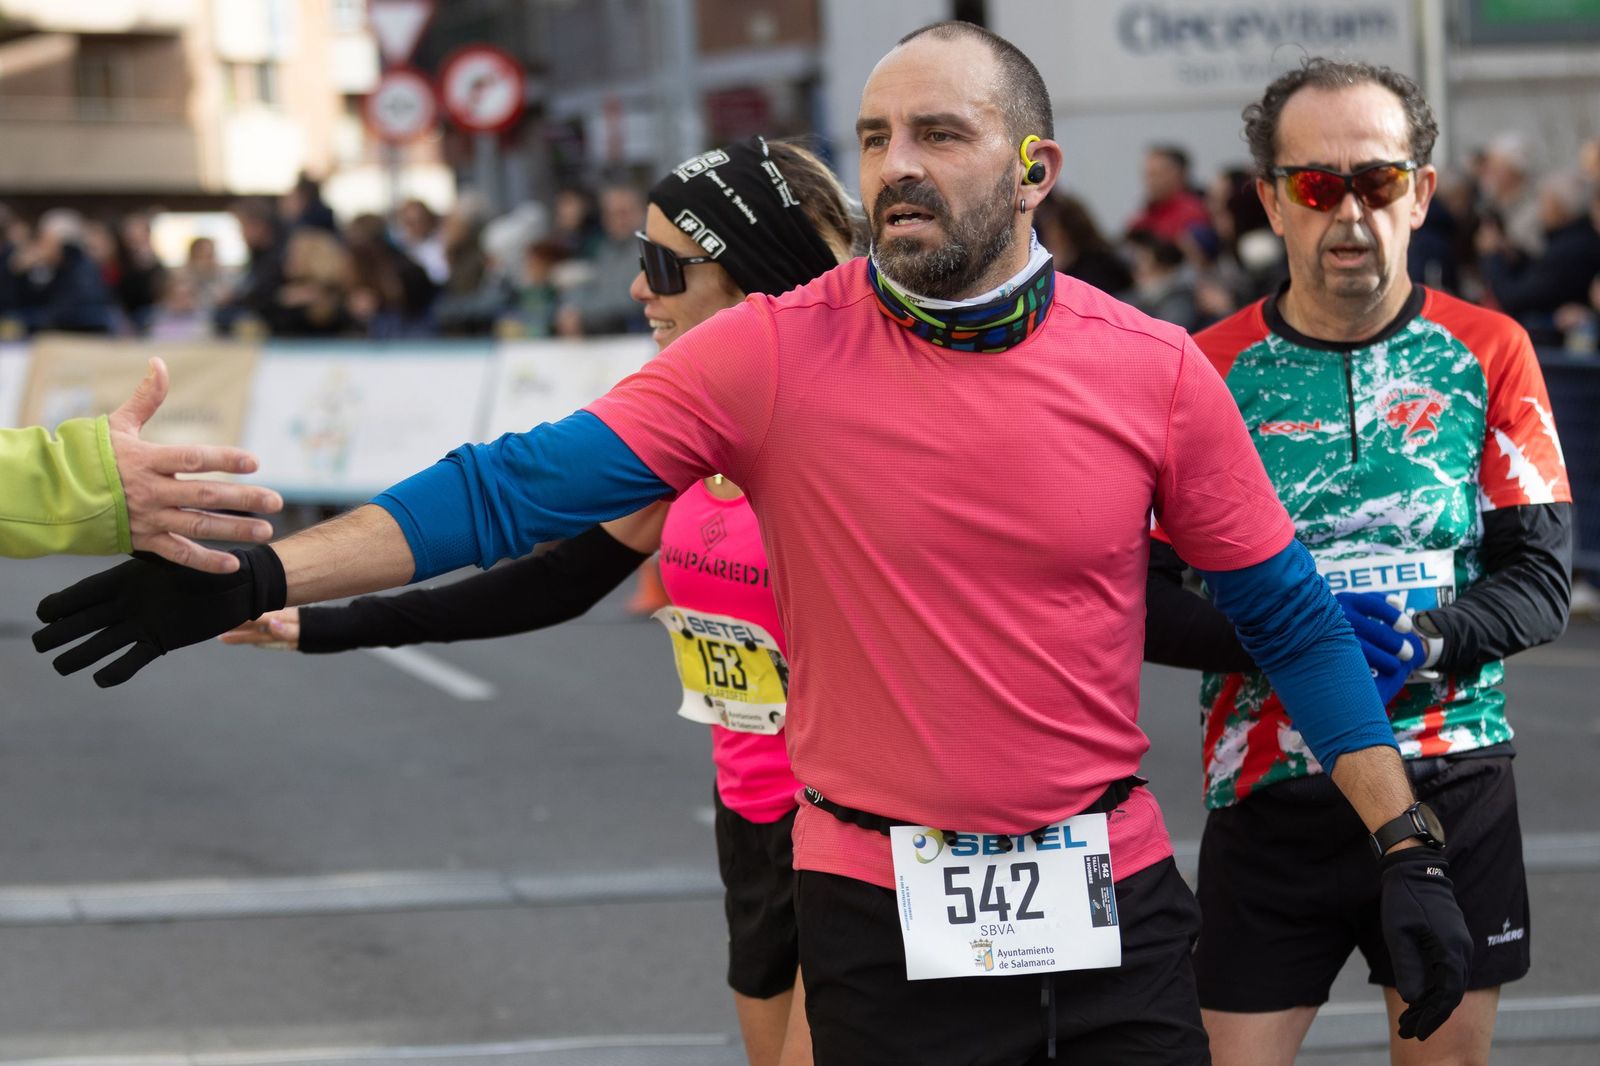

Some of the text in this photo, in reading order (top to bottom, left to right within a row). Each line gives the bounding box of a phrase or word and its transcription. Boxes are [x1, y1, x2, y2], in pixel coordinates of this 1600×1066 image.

[1324, 562, 1437, 590] SETEL
[687, 616, 764, 643] SETEL
[697, 639, 748, 690] 153
[1101, 863, 1110, 878] 542
[943, 862, 1045, 924] 542
[980, 923, 1015, 936] SBVA
[997, 946, 1055, 959] Ayuntamiento
[999, 959, 1056, 969] de Salamanca
